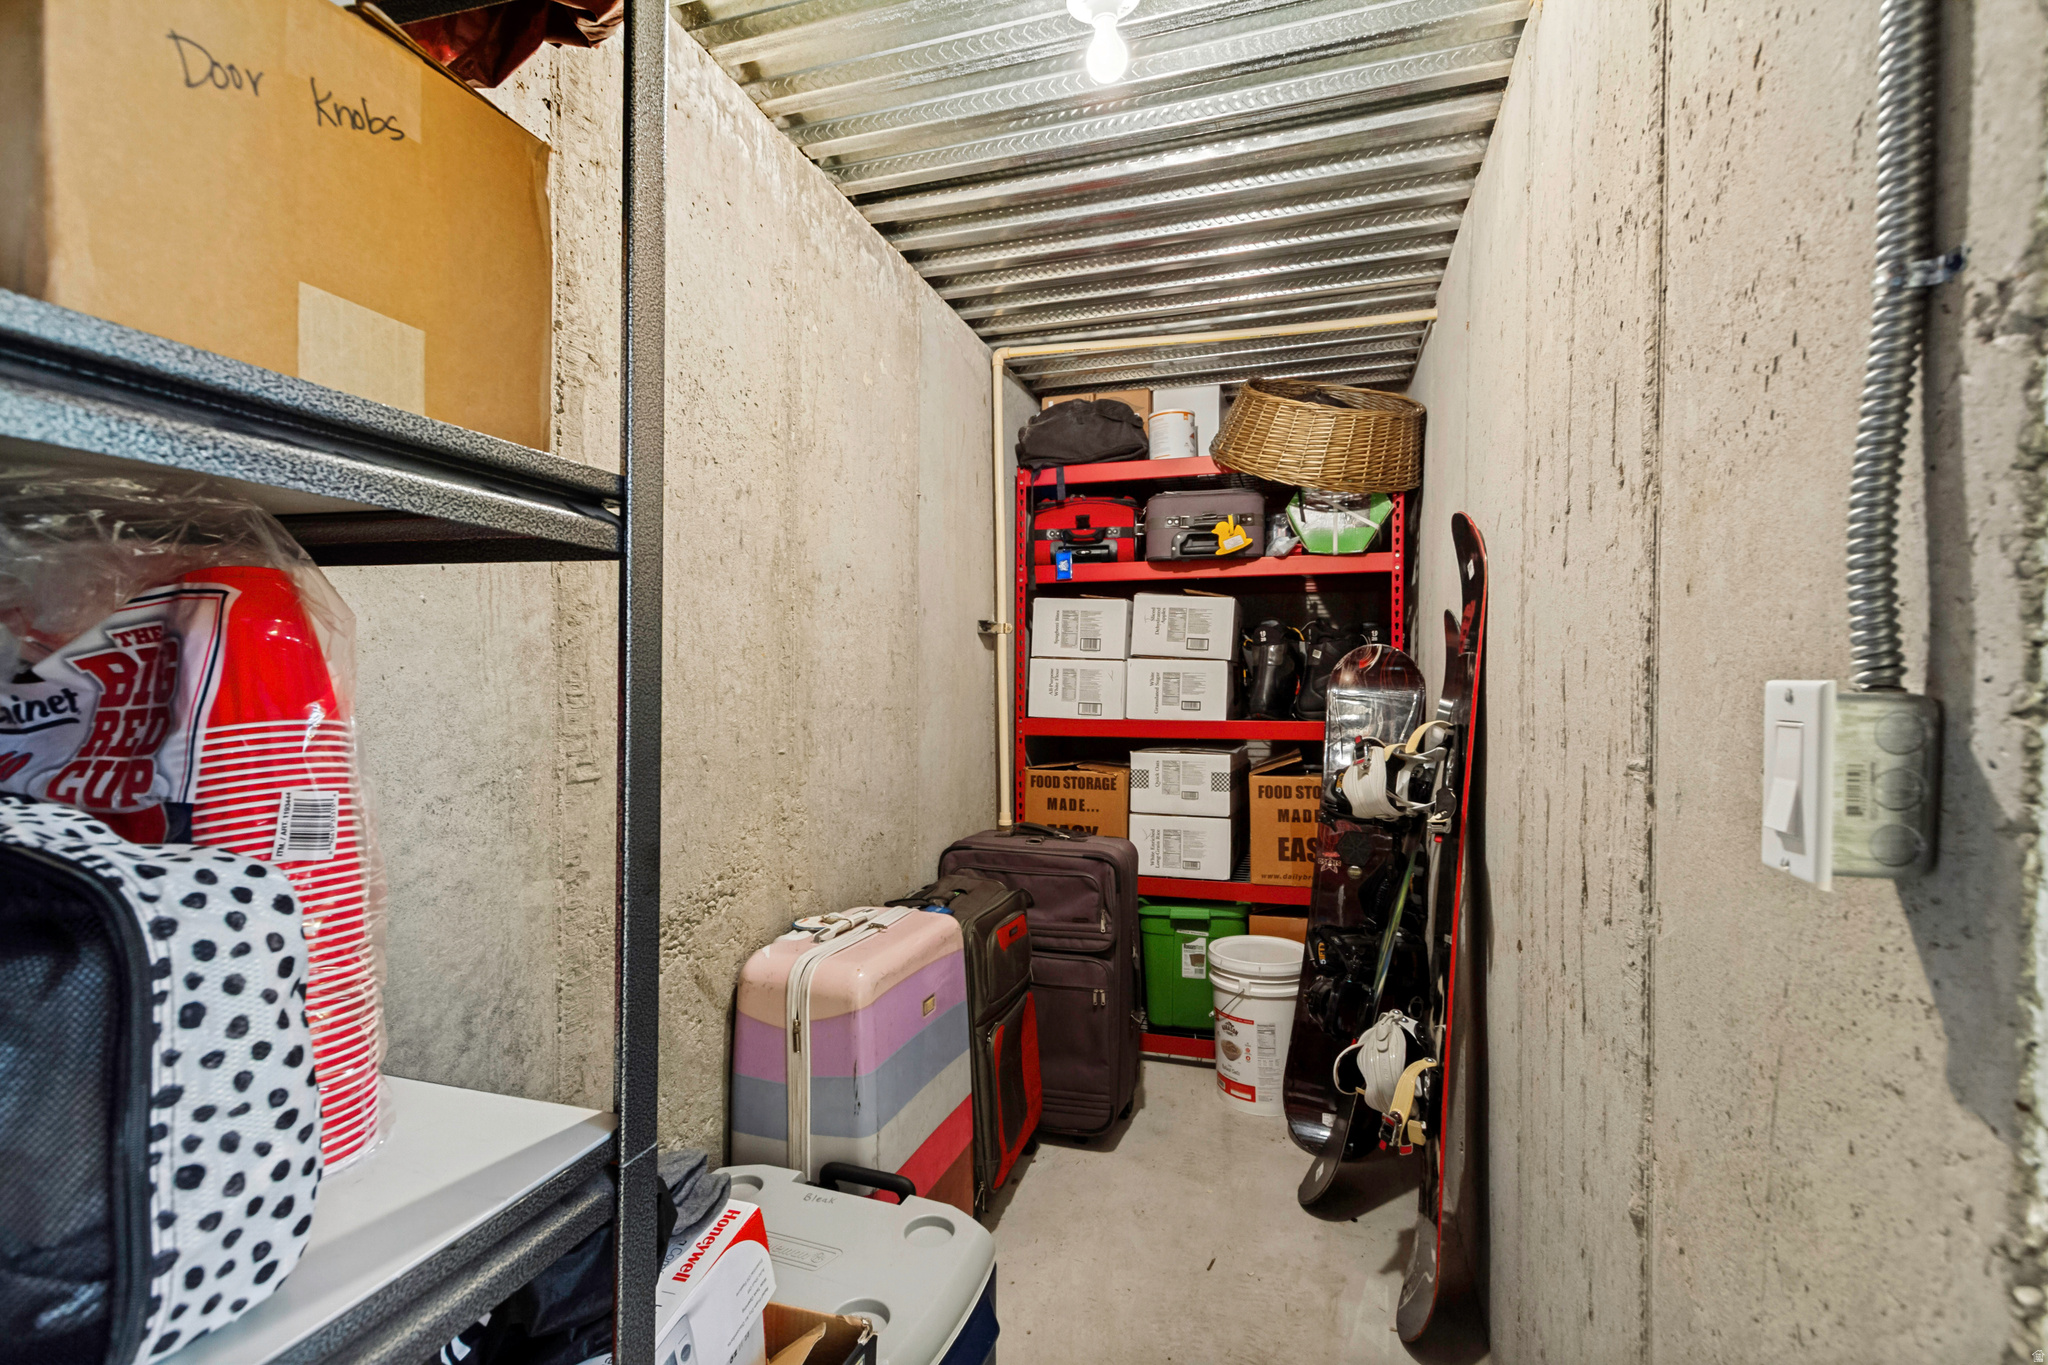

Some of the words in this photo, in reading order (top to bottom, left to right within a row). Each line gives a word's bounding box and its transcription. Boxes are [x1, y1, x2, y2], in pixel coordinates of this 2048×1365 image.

[165, 28, 264, 97] Door
[310, 76, 405, 141] Knobs
[111, 624, 164, 648] THE
[72, 640, 179, 708] BIG
[76, 706, 171, 758] RED
[46, 758, 154, 808] CUP
[1030, 775, 1060, 789] FOOD
[1063, 776, 1117, 791] STORAGE
[1258, 785, 1292, 799] FOOD
[1295, 785, 1321, 799] STO
[1278, 837, 1318, 862] EAS
[803, 1192, 837, 1204] Bleak
[672, 1209, 741, 1283] Honeywell
